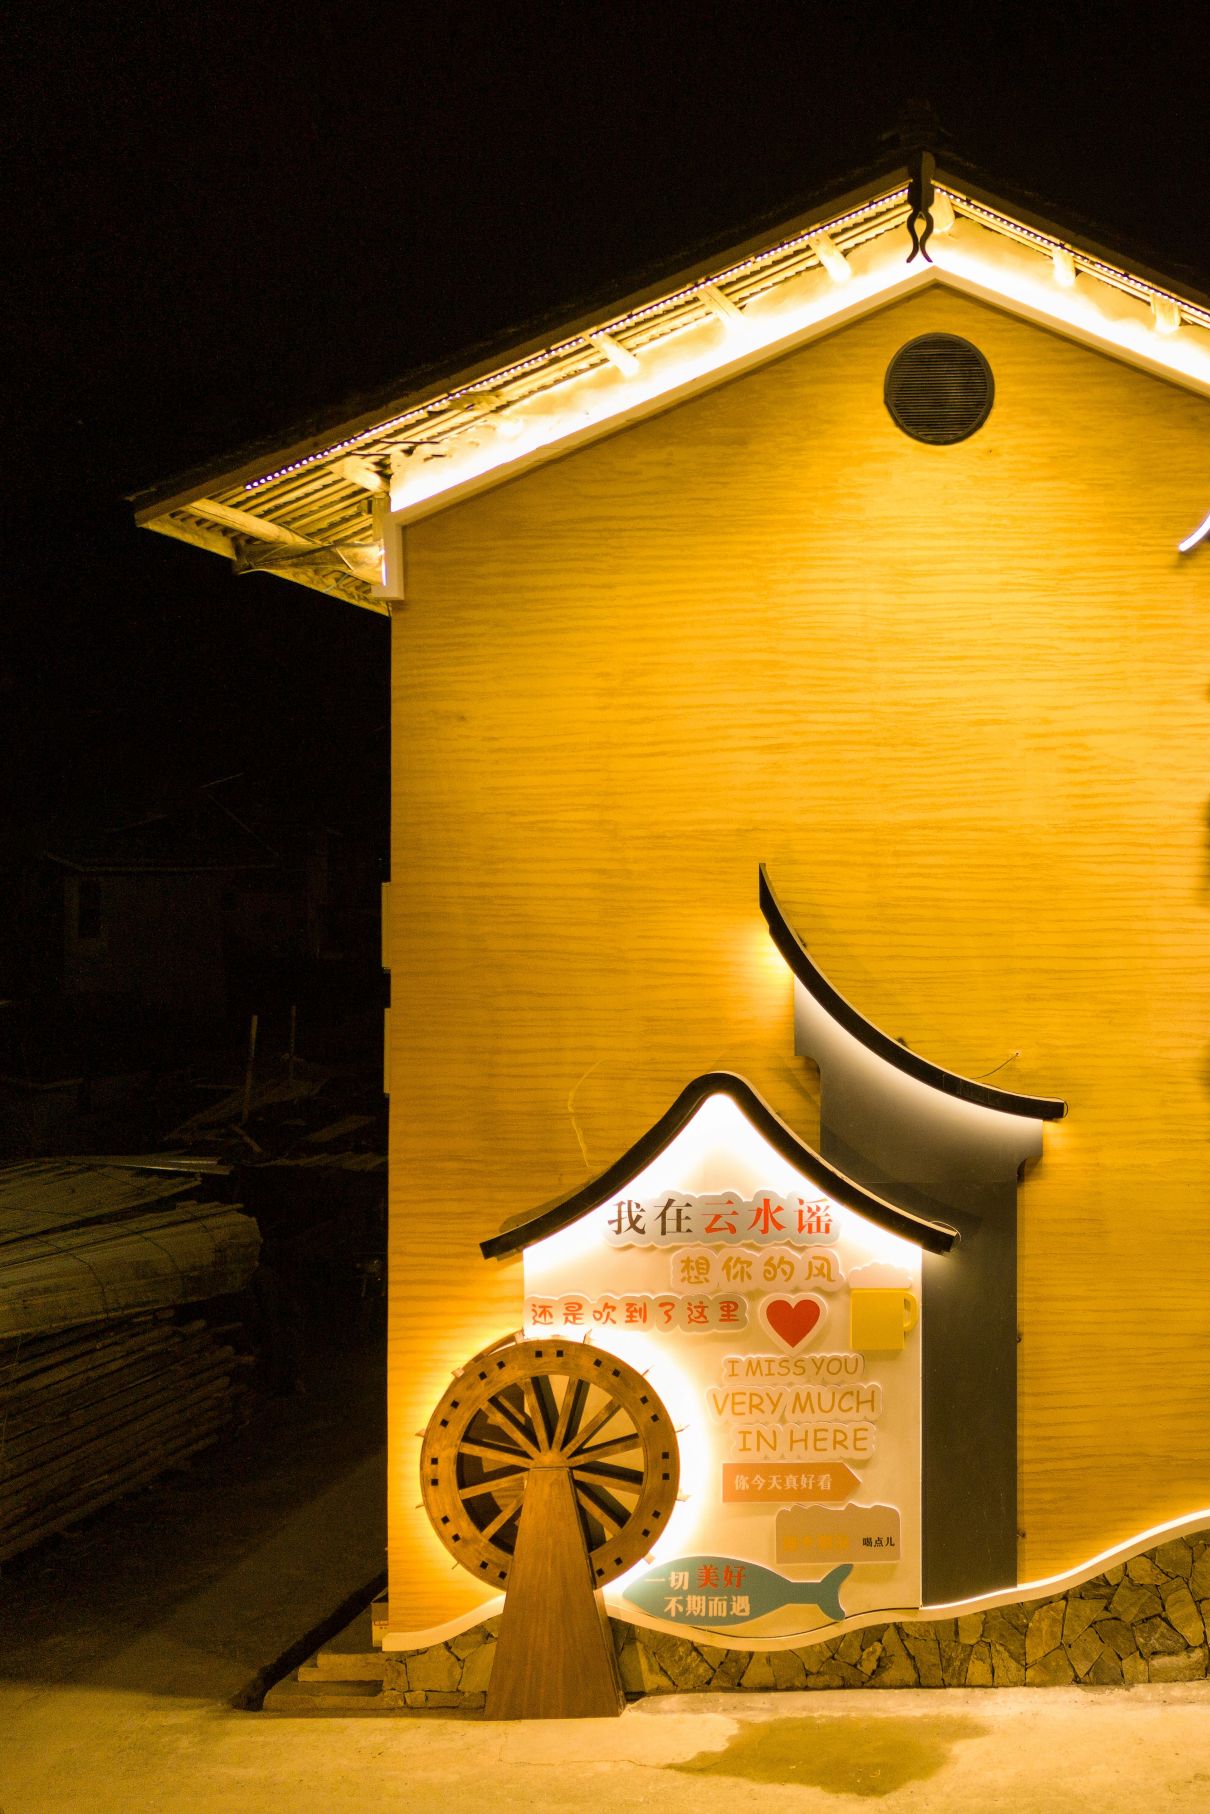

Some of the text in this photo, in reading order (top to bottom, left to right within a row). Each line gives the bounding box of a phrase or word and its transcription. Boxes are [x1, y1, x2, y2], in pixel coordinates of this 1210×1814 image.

[607, 1198, 834, 1236] 我在云水谣
[679, 1255, 836, 1286] 想你的风
[530, 1301, 740, 1326] 还是吹到了这里
[727, 1357, 860, 1378] I MISS YOU
[711, 1389, 876, 1416] VERY MUCH
[737, 1427, 869, 1453] IN HERE
[734, 1474, 833, 1492] 你今天真好看
[861, 1536, 896, 1548] 喝点儿
[663, 1594, 751, 1618] 不期而遇
